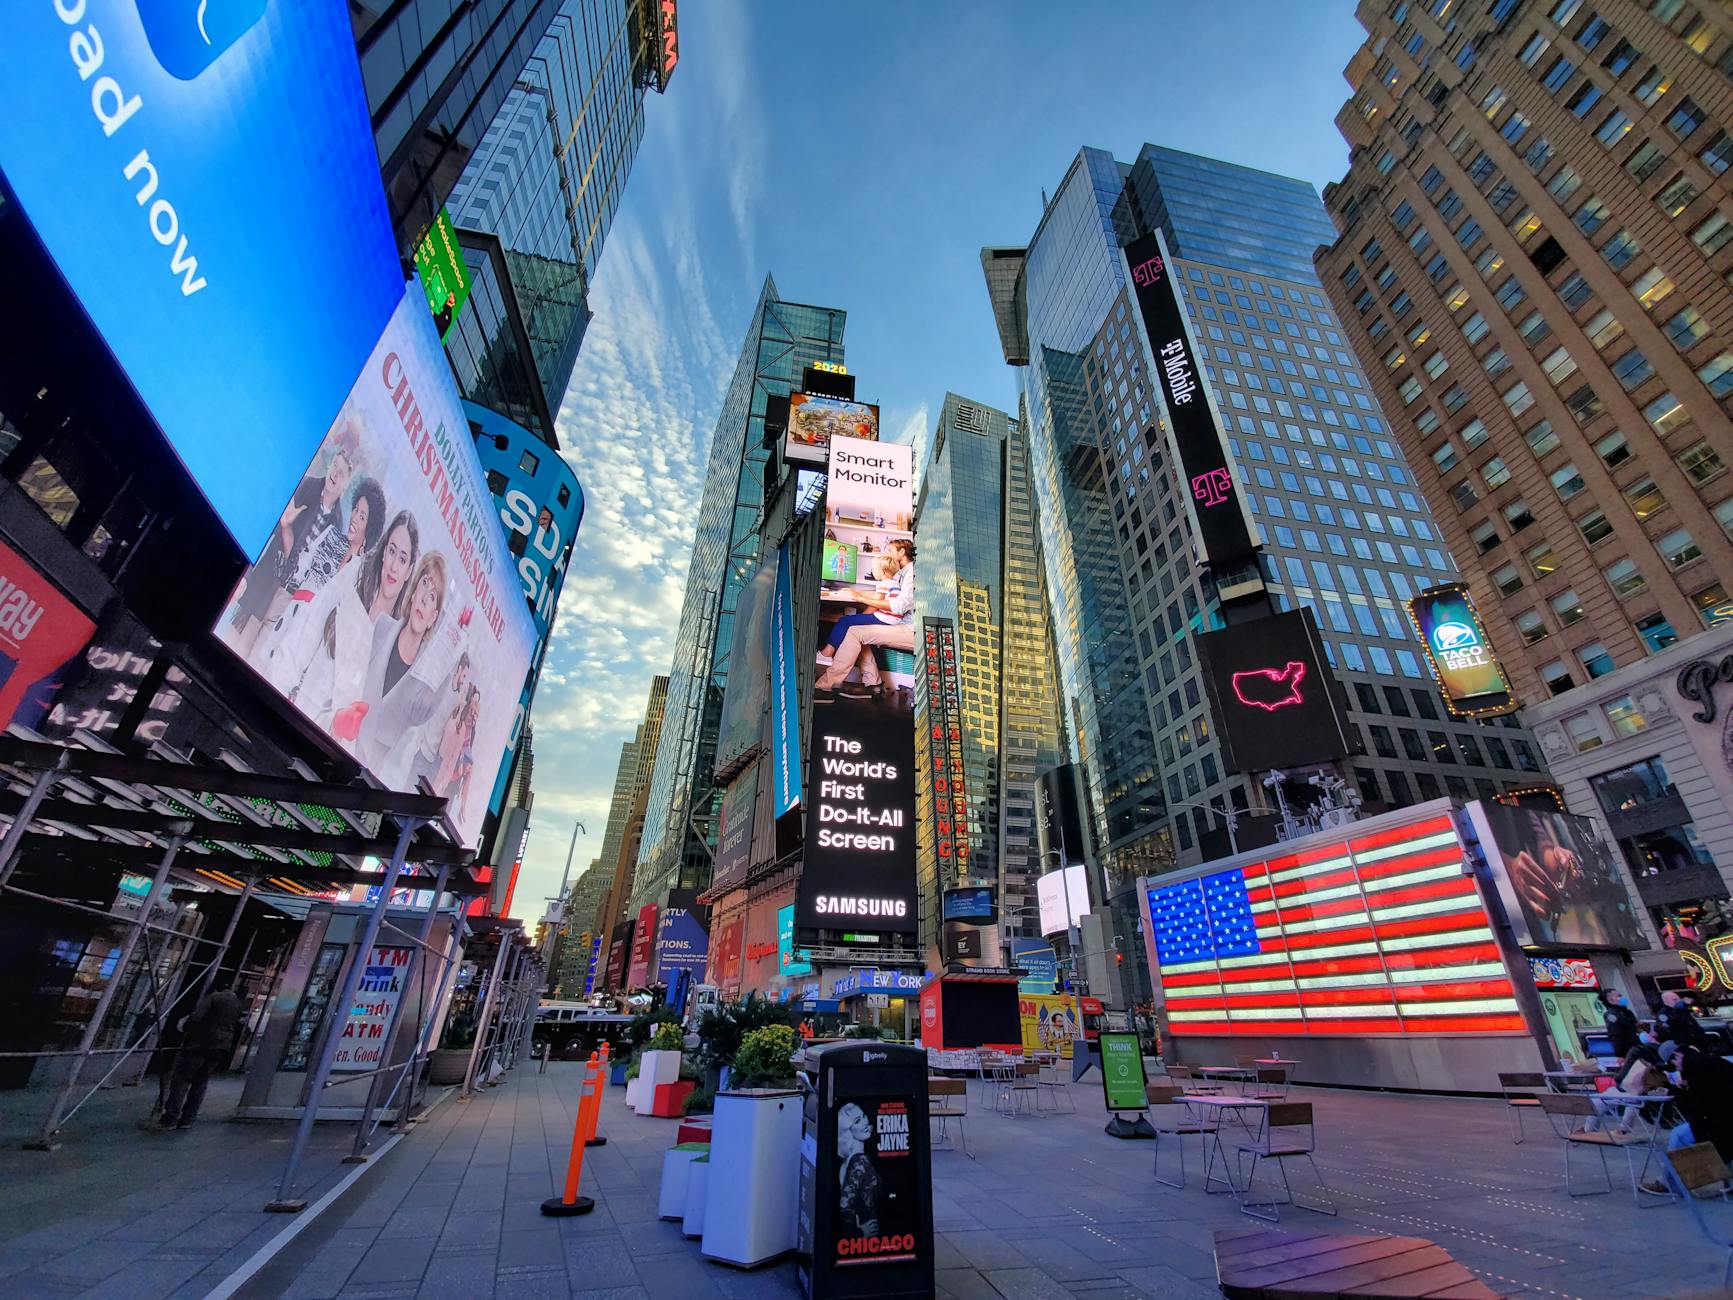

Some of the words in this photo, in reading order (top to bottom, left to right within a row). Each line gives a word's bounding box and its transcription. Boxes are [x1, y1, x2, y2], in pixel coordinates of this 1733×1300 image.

[123, 149, 208, 297] now
[437, 215, 464, 289] MakeSpace
[814, 361, 847, 375] 2020
[836, 450, 894, 470] Smart
[834, 468, 907, 489] Monitor
[382, 351, 464, 549] CHRISTMAS
[472, 563, 506, 644] SQUARE
[434, 420, 466, 501] DOLLY
[463, 496, 496, 574] PARTON'S
[1439, 646, 1482, 661] TACO
[1446, 655, 1489, 671] BELL
[932, 724, 943, 740] &
[824, 735, 862, 754] The
[781, 741, 790, 805] anywhere
[822, 758, 897, 779] World's
[821, 780, 865, 800] First
[820, 805, 903, 827] Do-It-All
[934, 757, 952, 858] YOUNG
[818, 829, 895, 851] Screen
[815, 897, 906, 917] SAMSUNG
[855, 934, 879, 942] TRADITION
[354, 999, 393, 1020] andy
[342, 1023, 383, 1038] ATM
[354, 1045, 381, 1062] Good
[863, 1051, 888, 1062] Bigbelly
[1108, 1043, 1132, 1051] THINK
[877, 1114, 909, 1133] ERIKA
[877, 1133, 910, 1151] JAYNE
[837, 1233, 915, 1256] CHICAGO
